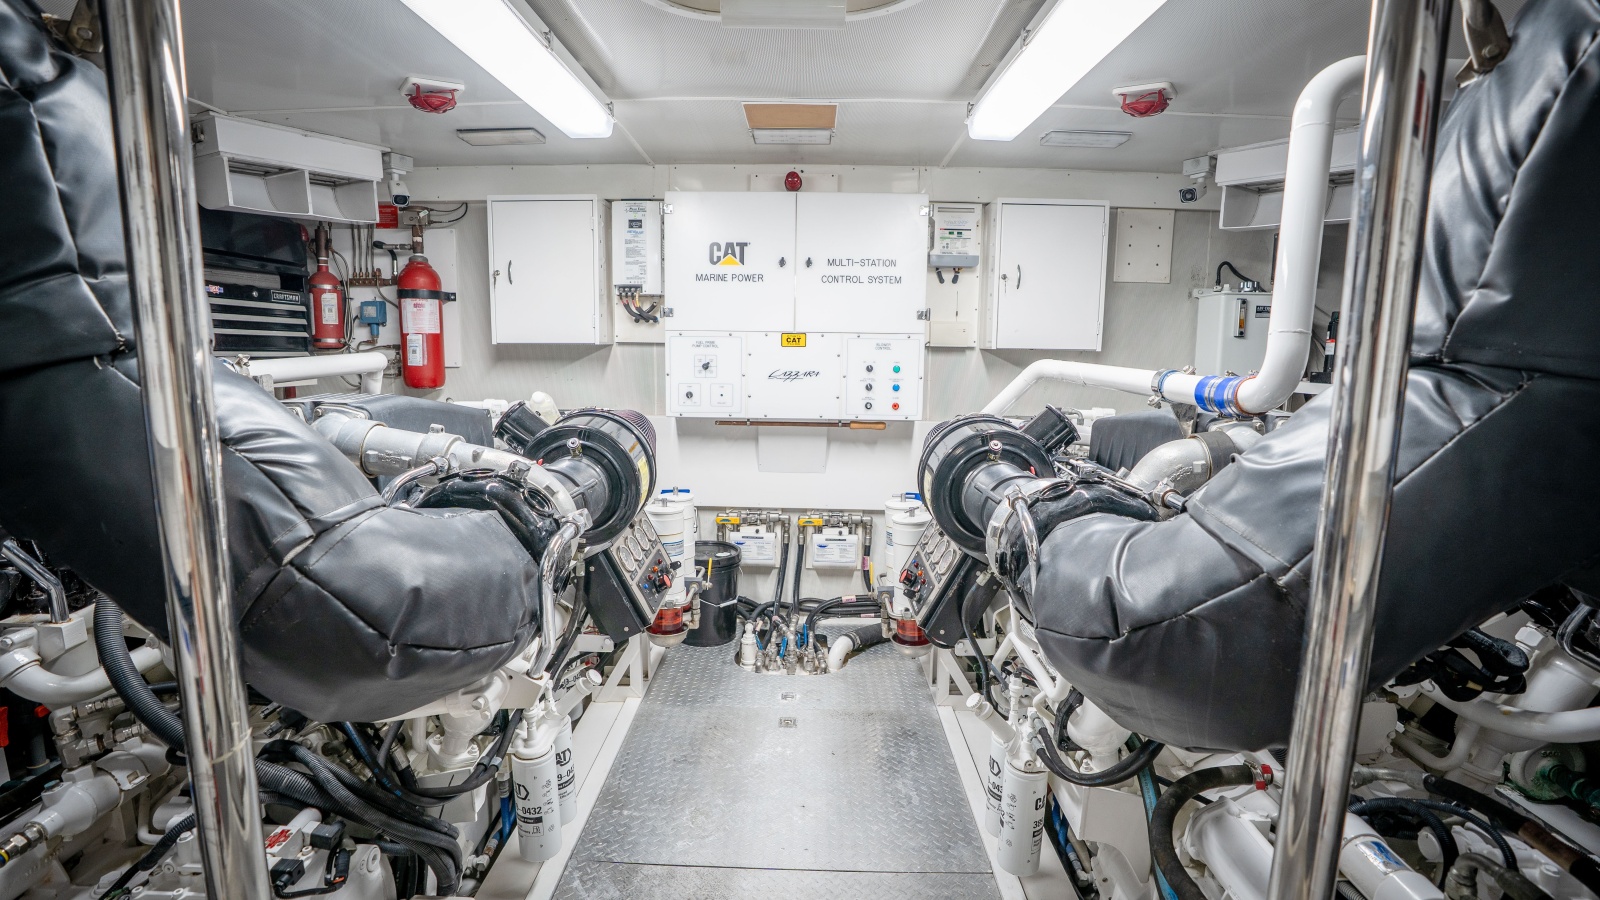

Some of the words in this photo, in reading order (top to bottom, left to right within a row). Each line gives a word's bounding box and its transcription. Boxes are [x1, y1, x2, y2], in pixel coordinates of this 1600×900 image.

[709, 241, 748, 266] CAT
[827, 258, 897, 267] MULTI-STATION
[695, 273, 729, 282] MARINE
[731, 273, 764, 283] POWER
[821, 275, 865, 284] CONTROL
[868, 275, 902, 285] SYSTEM
[273, 293, 299, 302] CRAFTSMAN
